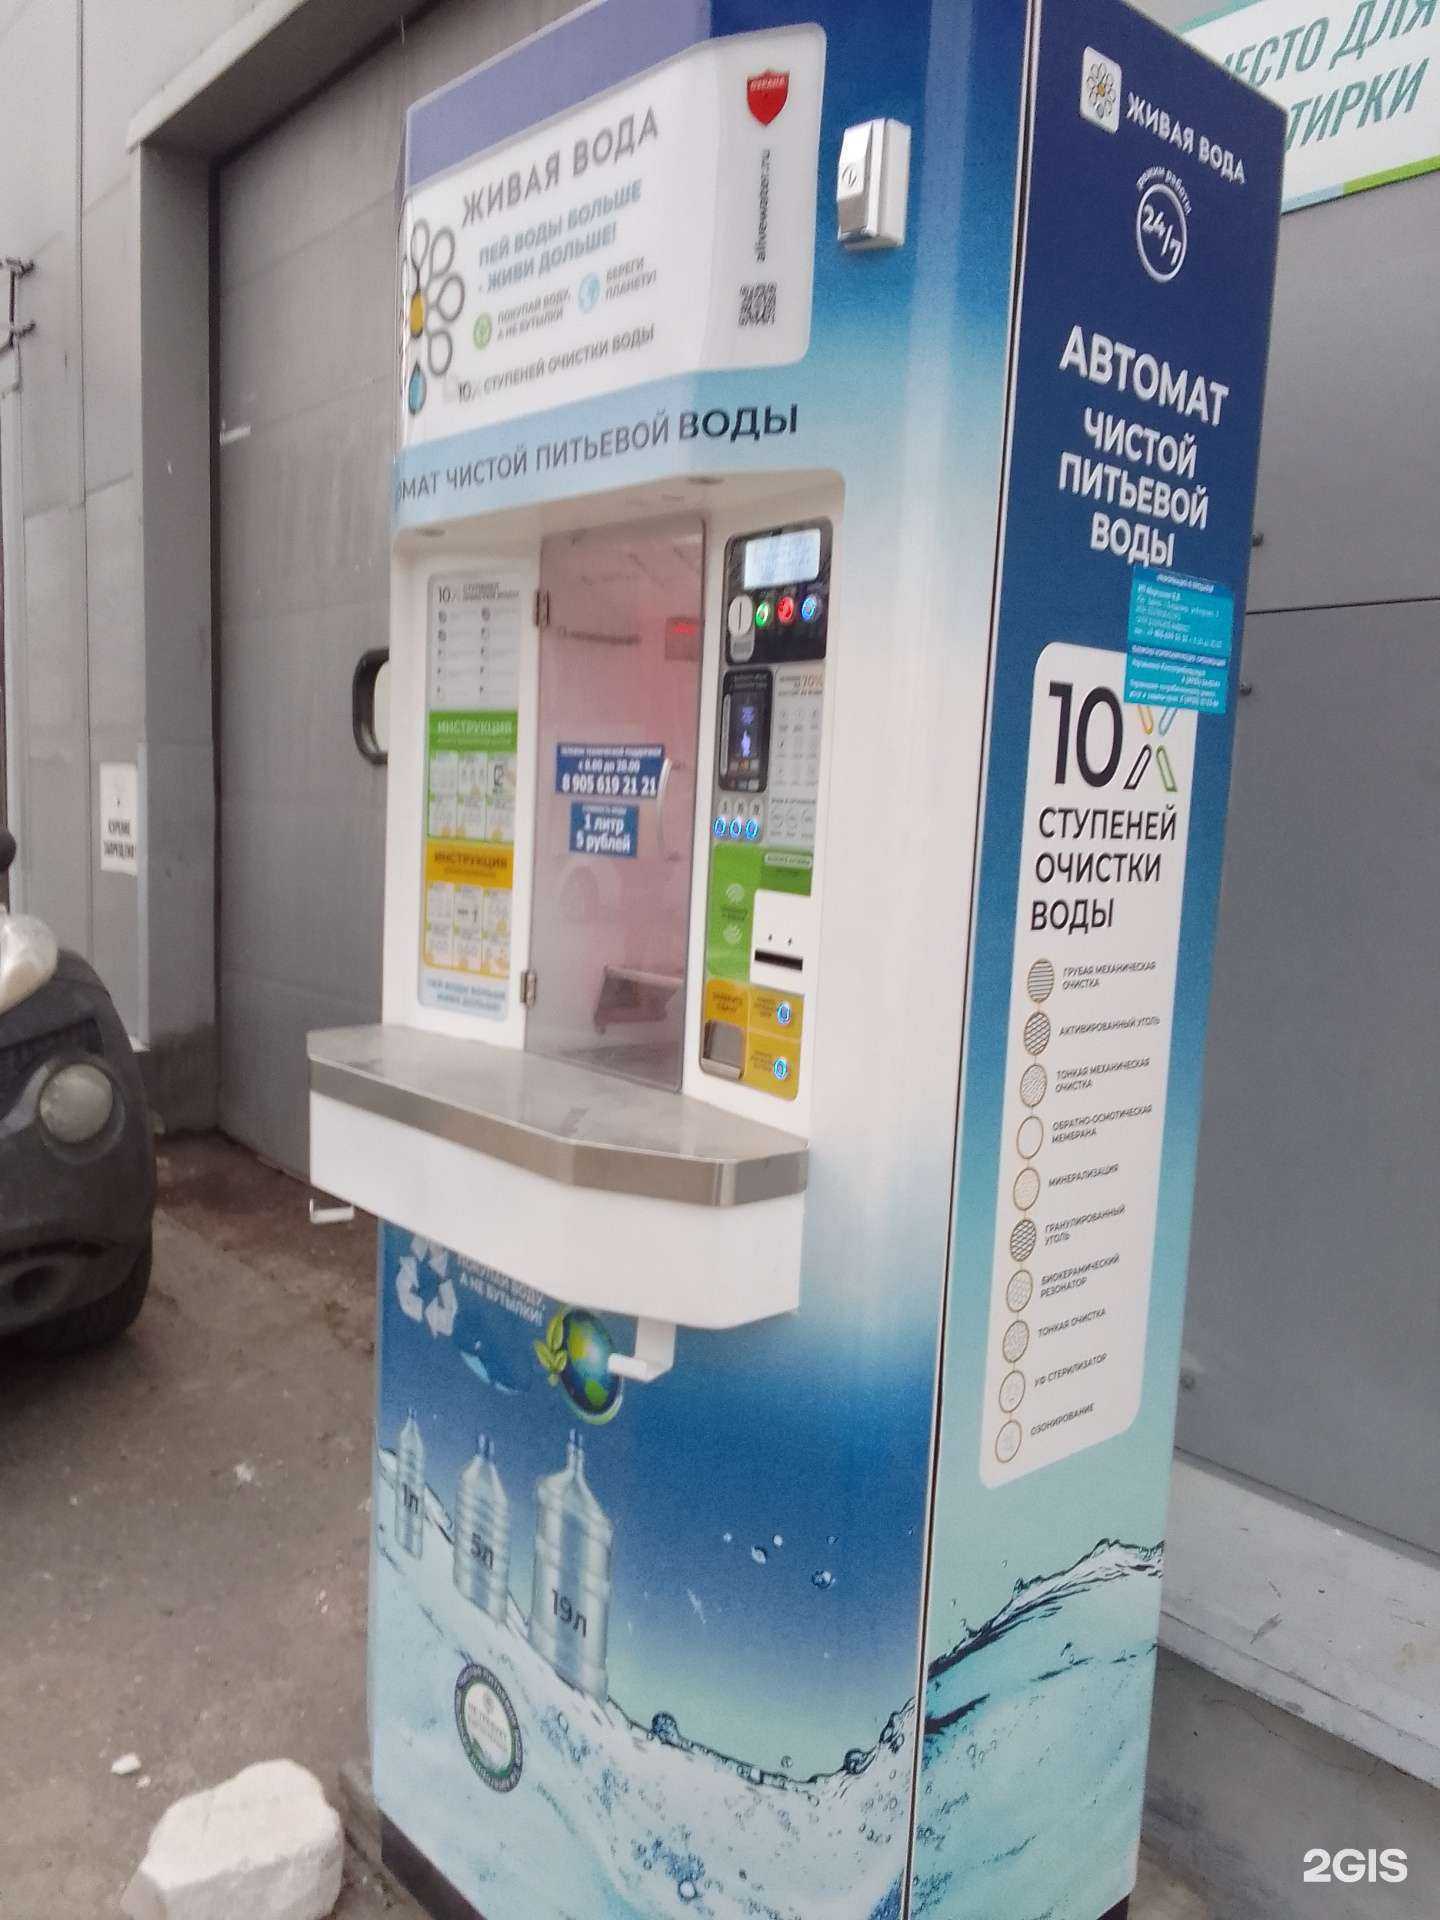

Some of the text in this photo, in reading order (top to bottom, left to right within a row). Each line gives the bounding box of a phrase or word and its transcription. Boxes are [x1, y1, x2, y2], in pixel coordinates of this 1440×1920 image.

[1329, 0, 1437, 70] ДЛЯ
[1126, 91, 1245, 184] ЖИВАЯ ВОДА
[462, 106, 658, 228] ЖИВАЯ ВОДА
[479, 178, 642, 268] ПЕЙ ВОДЫ БОЛЬШЕ
[1142, 204, 1182, 266] 24/7
[487, 257, 534, 292] ЖИВИ
[538, 222, 617, 276] ДОЛЬШЕ!
[484, 357, 545, 395] СТУПЕНЕЙ
[547, 339, 608, 374] ОЧИСТКИ
[612, 323, 655, 355] ВОДЫ
[1058, 324, 1230, 427] АВТОМАТ
[446, 444, 528, 490] ЧИСТОЙ
[536, 408, 670, 471] ПИТЬЕВОЙ
[679, 403, 798, 443] ВОДЫ
[1083, 406, 1198, 479] ЧИСТОЙ
[1058, 451, 1209, 530] ПИТЬЕВОЙ
[1090, 511, 1176, 567] ВОДЫ
[1049, 680, 1124, 788] 10
[572, 773, 595, 794] 905
[622, 775, 639, 796] 21
[641, 776, 657, 797] 21
[584, 812, 625, 836] 1 литр
[1039, 804, 1177, 841] СТУПЕНЕЙ
[586, 832, 631, 854] рублей
[1036, 852, 1161, 883] ОЧИСТКИ
[1030, 897, 1114, 935] ВОДЫ
[1062, 978, 1100, 991] ОЧИСТКА
[1094, 961, 1156, 975] МЕХАНИЧЕСКАЯ
[1058, 1018, 1137, 1036] АКТИВИРОВАННЫЙ
[1055, 1079, 1094, 1093] ОЧИСТКА
[1056, 1058, 1150, 1080] ТОНКАЯ МЕХАНИЧЕСКАЯ
[1051, 1128, 1097, 1144] МЕМБРАНА
[1048, 1163, 1119, 1187] МИНЕРАЛИЗАЦИЯ
[1045, 1203, 1126, 1233] ГРАНУЛИРОВАННЫЙ
[1044, 1232, 1071, 1247] УГОЛЬ
[1041, 1252, 1121, 1286] БИОКЕРАМИЧЕСКИЙ
[1039, 1276, 1088, 1299] РЕЗОНАТОР
[1038, 1308, 1107, 1338] ТОНКАЯ ОЧИСТКА
[1034, 1352, 1108, 1388] УФ СТЕРИЛИЗАТОР
[1030, 1402, 1096, 1436] ОЗОНИРОВАНИЕ
